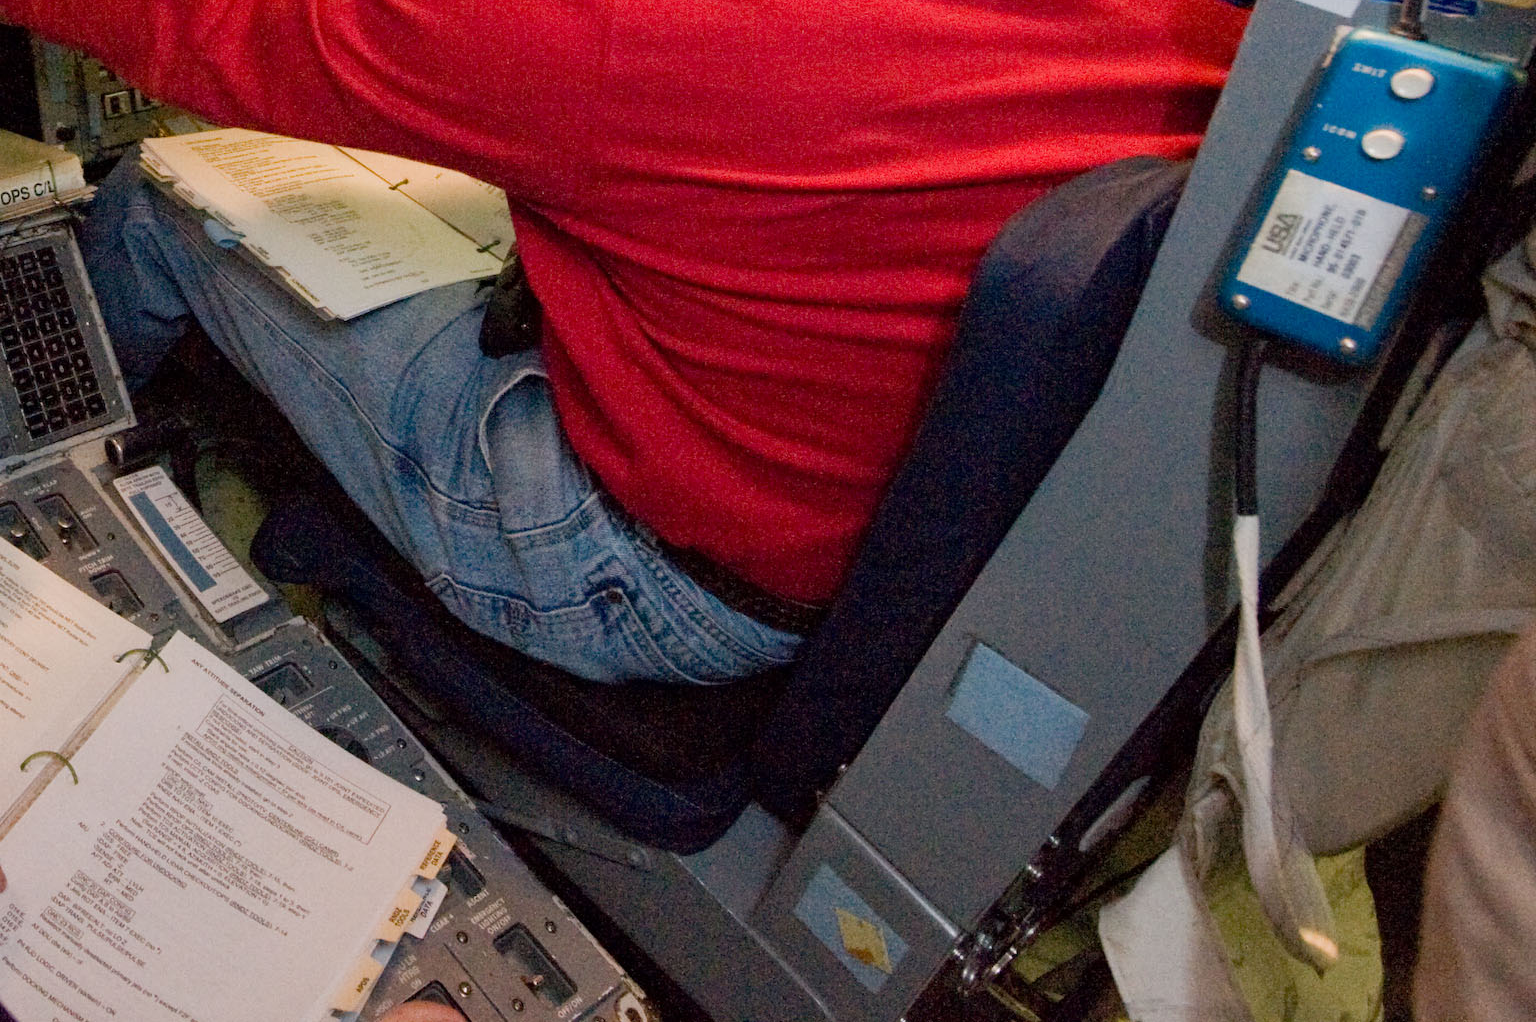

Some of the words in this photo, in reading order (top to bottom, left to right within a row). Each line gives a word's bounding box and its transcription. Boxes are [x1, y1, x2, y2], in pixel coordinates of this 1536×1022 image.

[1350, 61, 1388, 79] XMIT
[1321, 122, 1358, 140] ICOM
[0, 185, 31, 207] OPS
[34, 179, 56, 198] C/L
[1262, 207, 1297, 255] USA
[77, 561, 97, 574] PITCH
[97, 554, 114, 565] TRIM
[265, 655, 282, 667] TRIM
[191, 658, 205, 670] ANY
[203, 668, 229, 690] ATTITUDE
[230, 689, 265, 717] SEPARATION
[287, 745, 314, 764] CAUTION
[419, 840, 442, 871] REFERENCE
[431, 851, 444, 867] DATA
[119, 889, 135, 902] MED
[123, 884, 139, 897] MED
[466, 889, 490, 909] ASCENT
[388, 907, 403, 924] RNDZ
[394, 909, 411, 928] TOOLS
[420, 900, 434, 920] DATA
[470, 898, 506, 926] EMERGENCY
[478, 907, 508, 931] LIGHTING
[431, 918, 451, 934] CLEAR
[487, 915, 512, 936] ON/OFF
[0, 956, 24, 976] Perform
[20, 974, 49, 996] DOCKING
[45, 992, 85, 1022] MECHANISM
[54, 970, 79, 990] DRIVEN
[104, 1006, 116, 1017] ON
[557, 996, 584, 1022] OFF/ON
